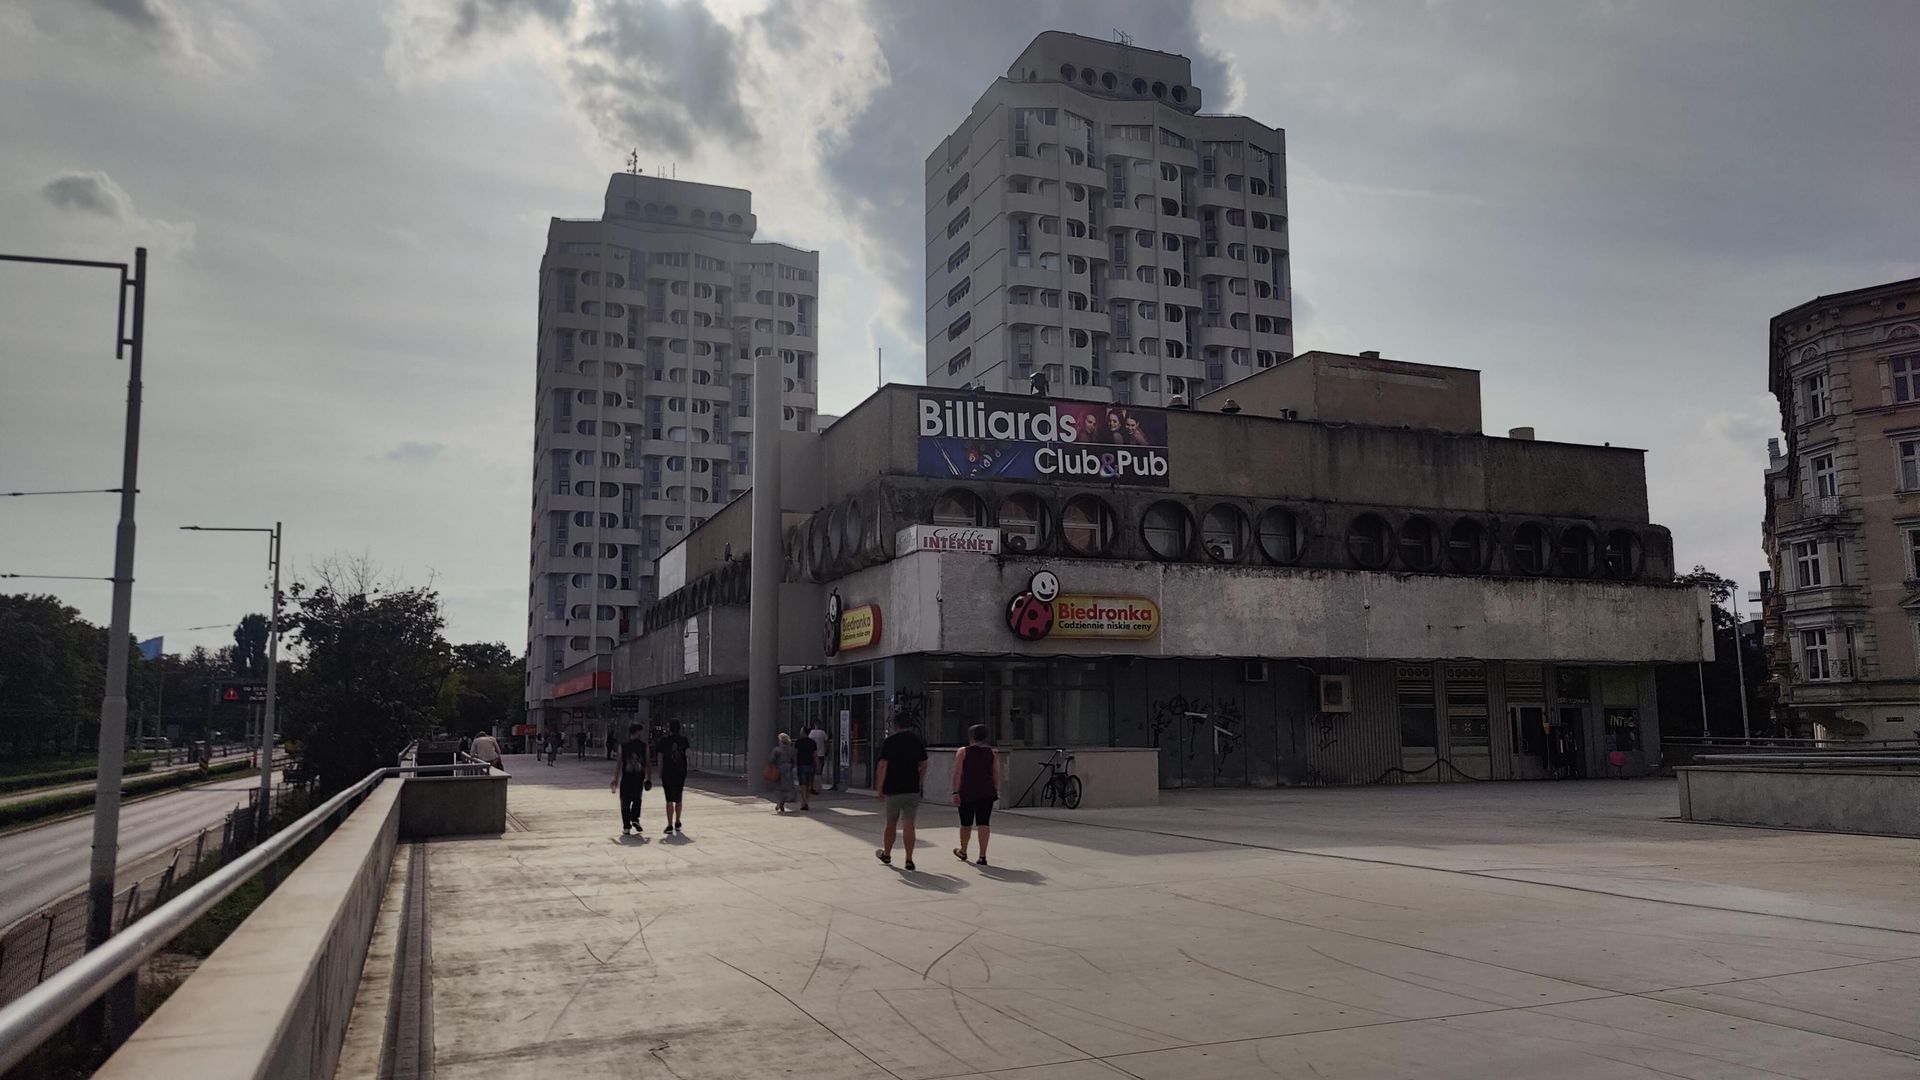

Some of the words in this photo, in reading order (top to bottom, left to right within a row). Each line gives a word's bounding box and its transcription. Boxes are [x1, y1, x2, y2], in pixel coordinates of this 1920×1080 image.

[919, 398, 1077, 443] Billiards
[933, 528, 984, 541] Caffe
[923, 536, 994, 551] INTERNET
[1058, 602, 1152, 621] Biedronka
[842, 614, 871, 632] Biedronka
[1058, 620, 1104, 629] Codziennie
[1107, 621, 1130, 630] niskie
